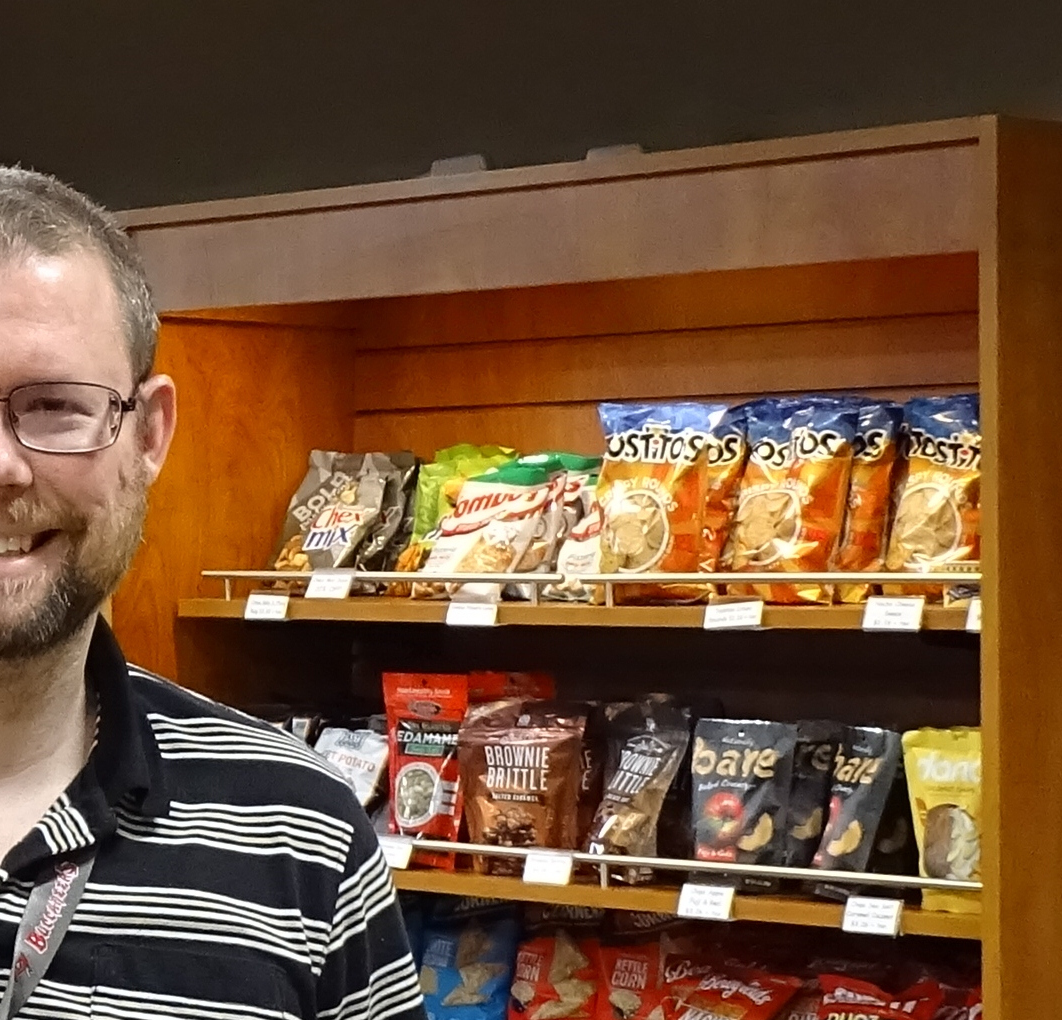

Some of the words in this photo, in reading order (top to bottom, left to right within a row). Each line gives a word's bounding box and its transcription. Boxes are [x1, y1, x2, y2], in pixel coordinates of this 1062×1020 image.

[292, 471, 353, 523] BOLD
[396, 730, 459, 746] EDAMAME
[338, 753, 377, 773] POTATO
[484, 745, 551, 770] BROWNIE
[619, 749, 661, 777] ROWNIE
[691, 736, 780, 779] bare
[485, 766, 551, 792] BRITTLE
[24, 862, 80, 954] BUCCANEERS
[614, 958, 648, 974] KETTLE
[610, 970, 648, 989] CORN
